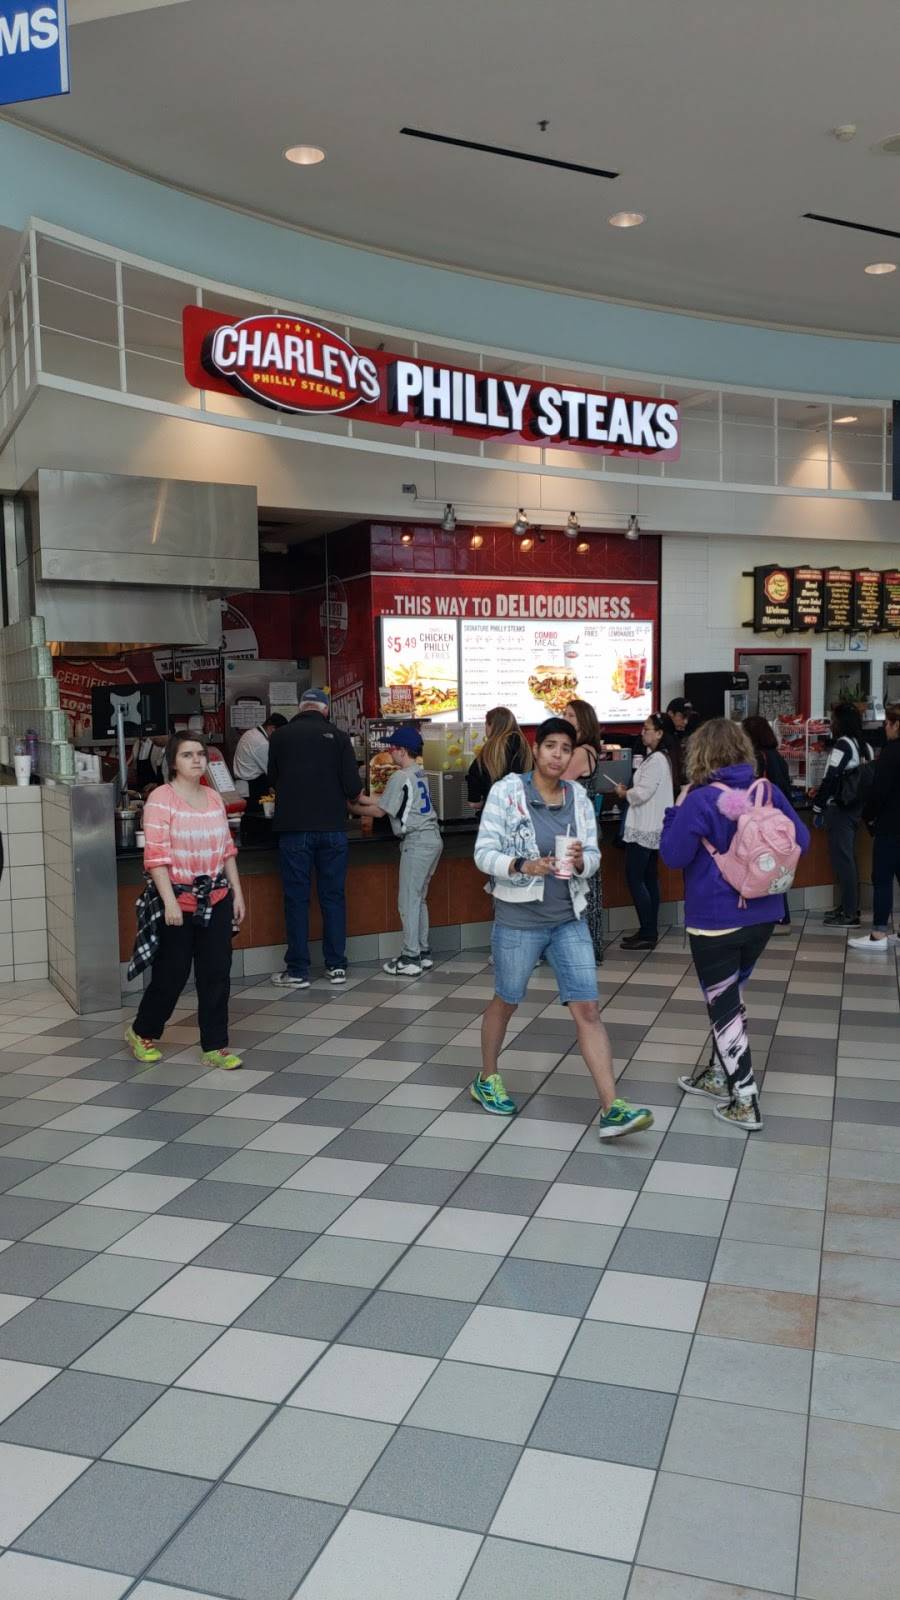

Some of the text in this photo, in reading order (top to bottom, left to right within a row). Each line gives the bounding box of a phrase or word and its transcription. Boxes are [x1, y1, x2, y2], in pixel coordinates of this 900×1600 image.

[214, 328, 379, 398] CHARLEYS
[253, 373, 346, 400] PHILLY STEAKS
[397, 360, 679, 449] PHILLY STEAKS
[435, 596, 468, 616] WAY
[472, 597, 491, 616] TO
[496, 594, 635, 619] DELICIOUSNESS.
[387, 635, 417, 653] $5.49
[420, 633, 454, 642] CHICKEN
[424, 642, 450, 652] PHILLY
[534, 632, 558, 640] COMBO
[417, 781, 431, 814] 3
